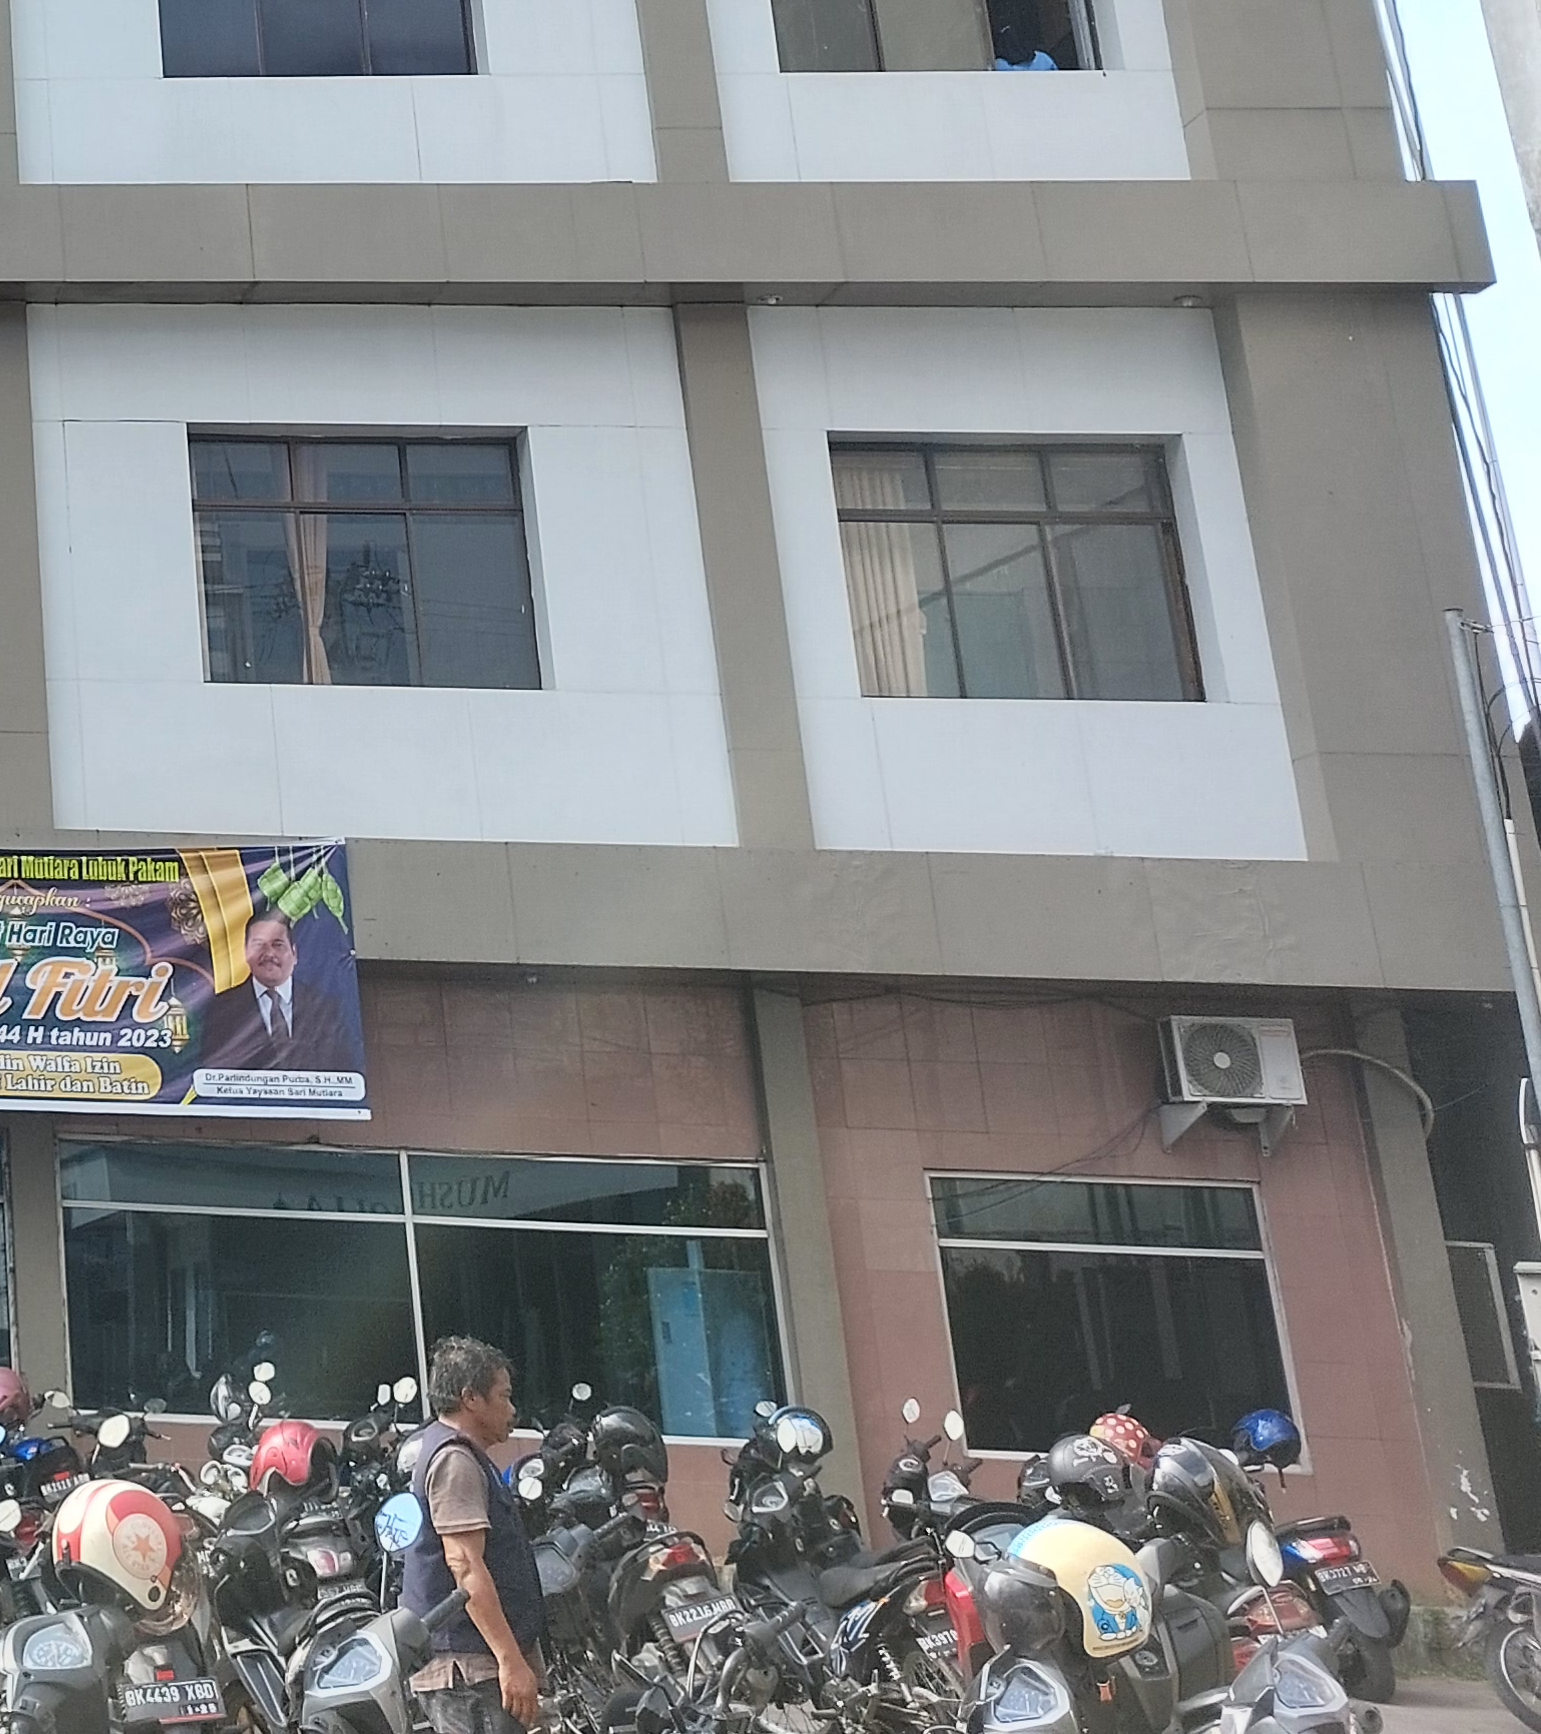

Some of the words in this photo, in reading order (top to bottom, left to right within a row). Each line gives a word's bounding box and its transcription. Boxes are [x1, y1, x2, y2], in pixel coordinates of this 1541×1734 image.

[21, 855, 78, 880] Mutiara
[81, 857, 126, 881] Lubuk
[128, 858, 179, 882] Pakam
[6, 920, 55, 946] Hari
[57, 922, 119, 952] Raya
[21, 956, 175, 1023] Fitri
[26, 1026, 45, 1045] H
[49, 1027, 113, 1047] tahun
[117, 1028, 173, 1048] 2023
[84, 1056, 122, 1075] Izin
[5, 1074, 58, 1093] Lahir
[61, 1075, 98, 1094] dan
[99, 1077, 151, 1095] Batin
[216, 1086, 244, 1095] Ketua
[287, 1087, 307, 1096] Sari
[308, 1088, 343, 1097] Mutiara
[125, 1688, 147, 1707] BK
